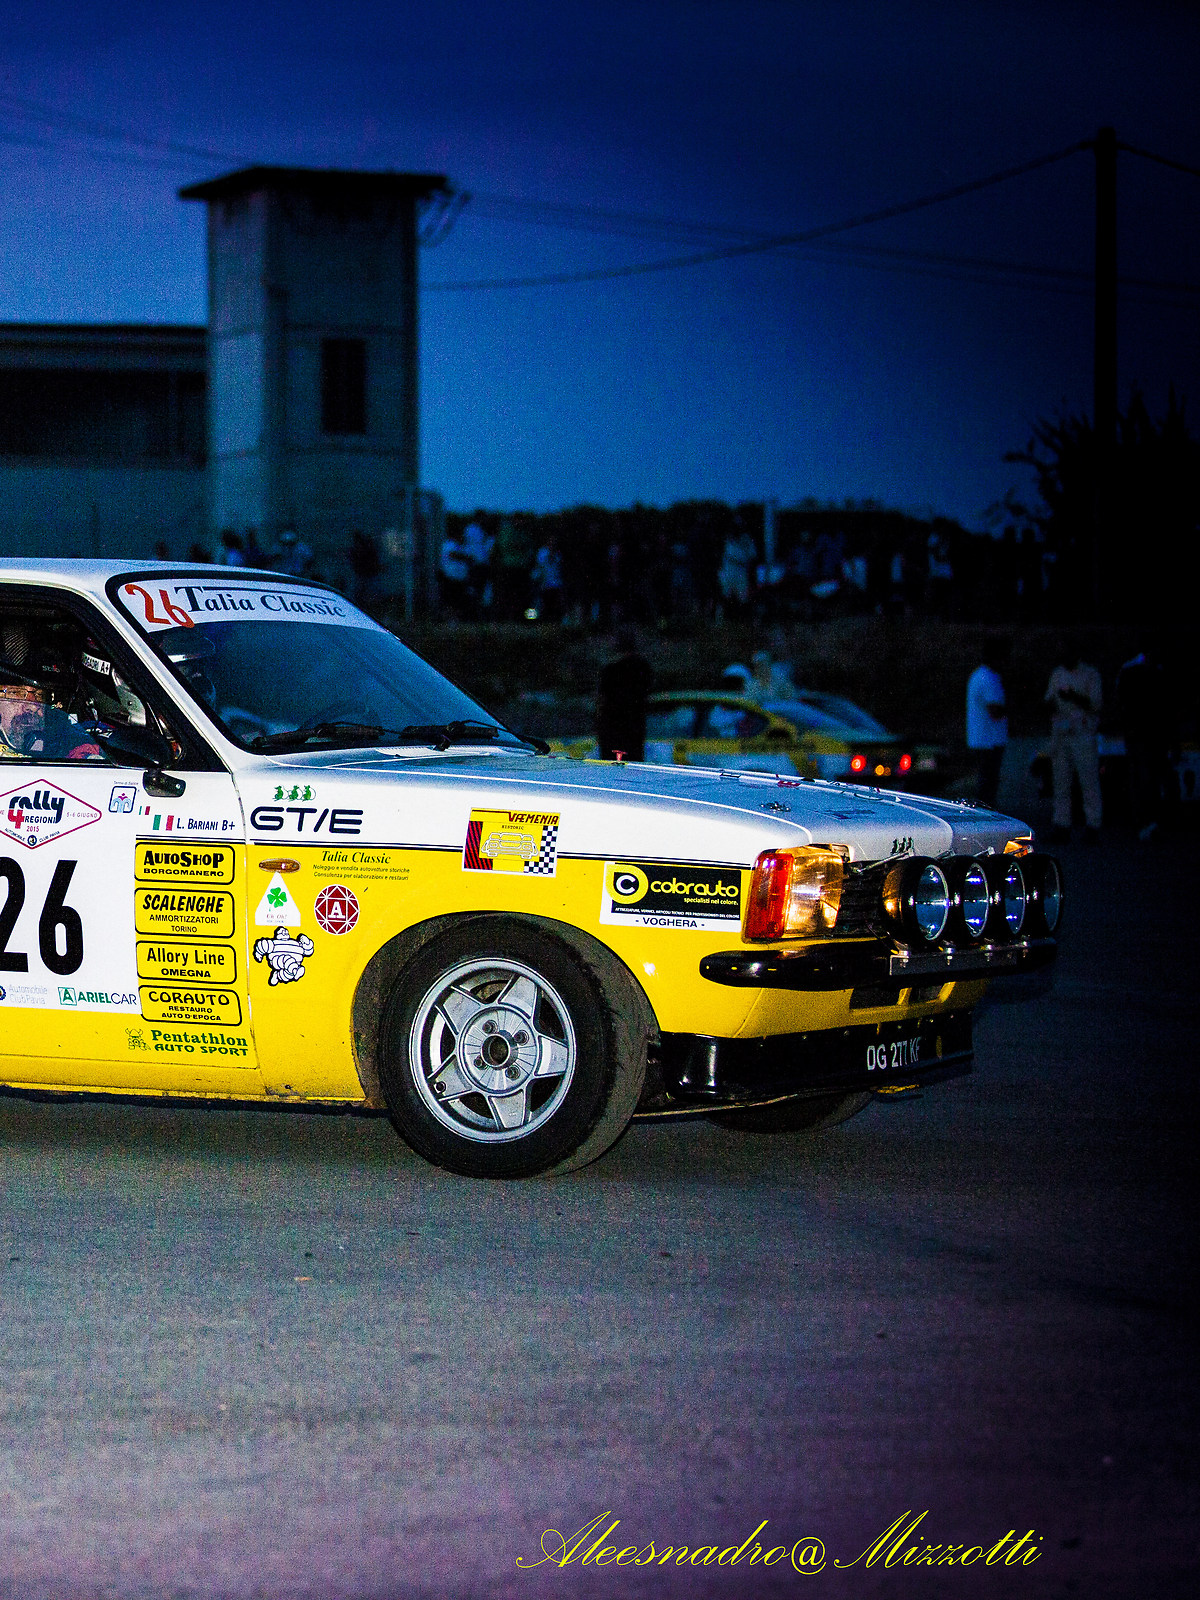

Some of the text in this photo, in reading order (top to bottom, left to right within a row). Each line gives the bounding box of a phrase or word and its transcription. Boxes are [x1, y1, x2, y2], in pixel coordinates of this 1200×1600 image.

[124, 583, 347, 628] 26 Talia Classic
[9, 790, 65, 823] rally
[8, 809, 57, 829] 4 REGIONI
[177, 818, 236, 832] L. BARIANI B+
[321, 850, 392, 865] Talia Classic
[143, 868, 224, 877] BORGOMANERO
[313, 864, 335, 872] Noleggio
[650, 877, 739, 898] colorauto
[142, 894, 225, 913] SCALENGHE
[327, 901, 346, 919] A
[149, 914, 219, 924] AMMORTIZZATORI
[643, 917, 698, 928] VOGHERA
[171, 925, 198, 933] TORINO
[146, 947, 225, 966] Allory Line
[161, 968, 211, 978] OMEGNA
[78, 991, 137, 1006] ARIELCAR
[149, 990, 230, 1006] CORAUTO
[161, 1012, 221, 1021] AUTO D'EPOCA
[168, 1005, 213, 1014] RESTAURO
[151, 1029, 248, 1047] Pentathlon
[154, 1043, 248, 1056] AUTO SPORT
[890, 1041, 908, 1068] 277
